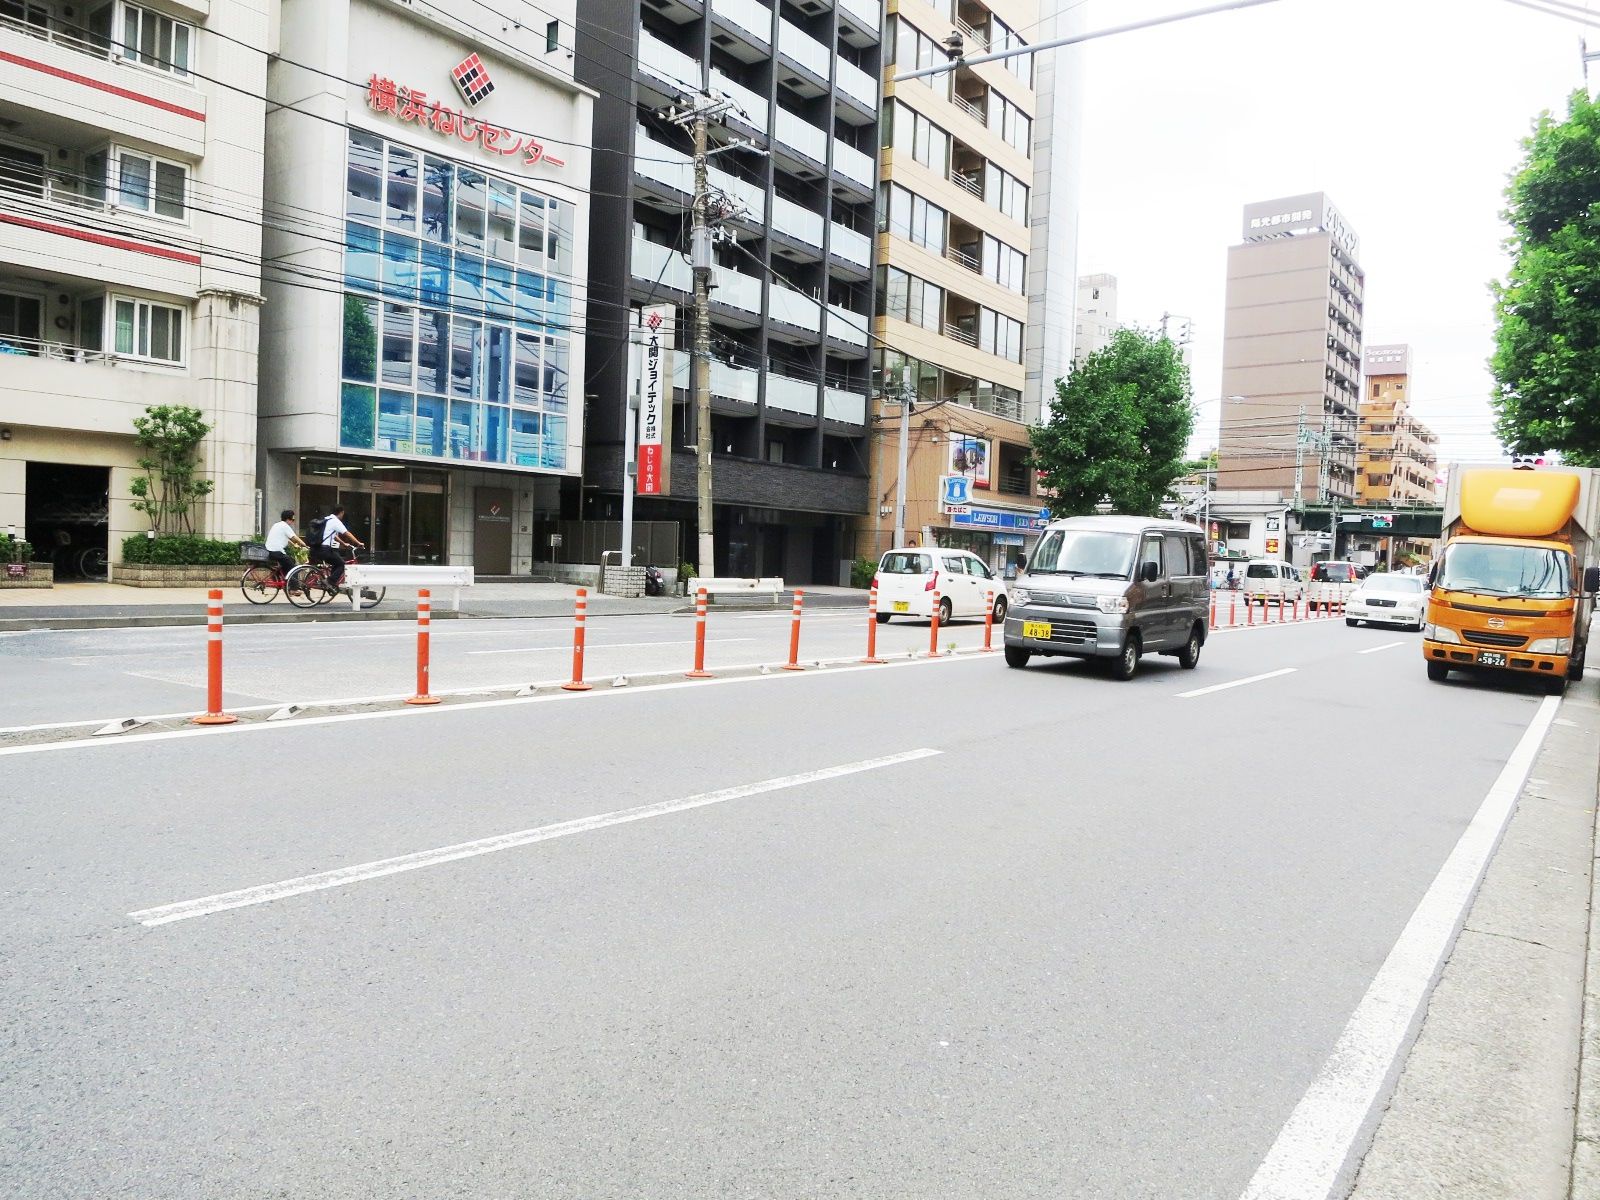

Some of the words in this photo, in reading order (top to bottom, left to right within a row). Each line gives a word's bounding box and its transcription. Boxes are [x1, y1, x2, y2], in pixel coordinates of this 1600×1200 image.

[368, 73, 565, 168] 横浜ねじセンター
[973, 513, 998, 523] LAWSON
[1029, 628, 1050, 637] 48-38
